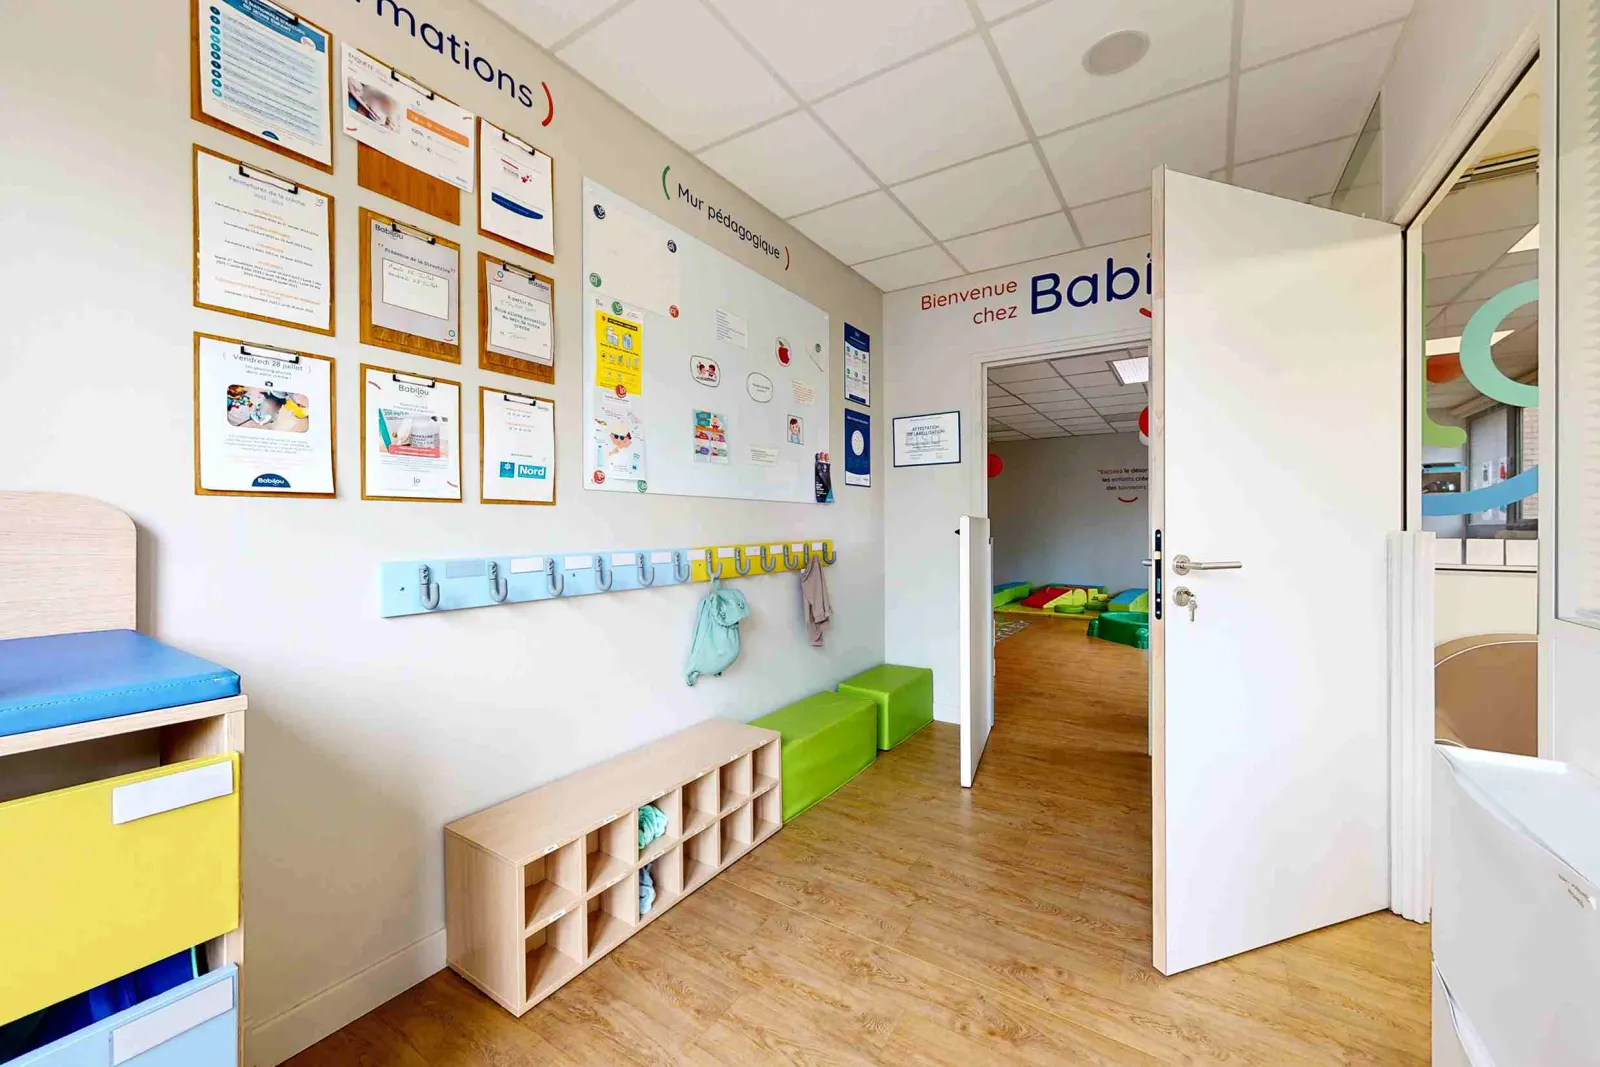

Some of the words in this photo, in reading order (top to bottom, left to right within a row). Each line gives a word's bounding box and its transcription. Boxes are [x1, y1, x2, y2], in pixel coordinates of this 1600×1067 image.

[355, 0, 533, 108] mations
[678, 183, 704, 210] Mur
[708, 205, 780, 259] pédagogique
[921, 280, 1018, 311] Bienvenue
[972, 305, 1018, 325] chez
[232, 354, 270, 366] Vendredi
[272, 359, 281, 367] 28
[282, 363, 303, 372] juillet
[398, 384, 429, 396] Babilou
[520, 465, 545, 476] Nord
[257, 477, 285, 485] Babilou
